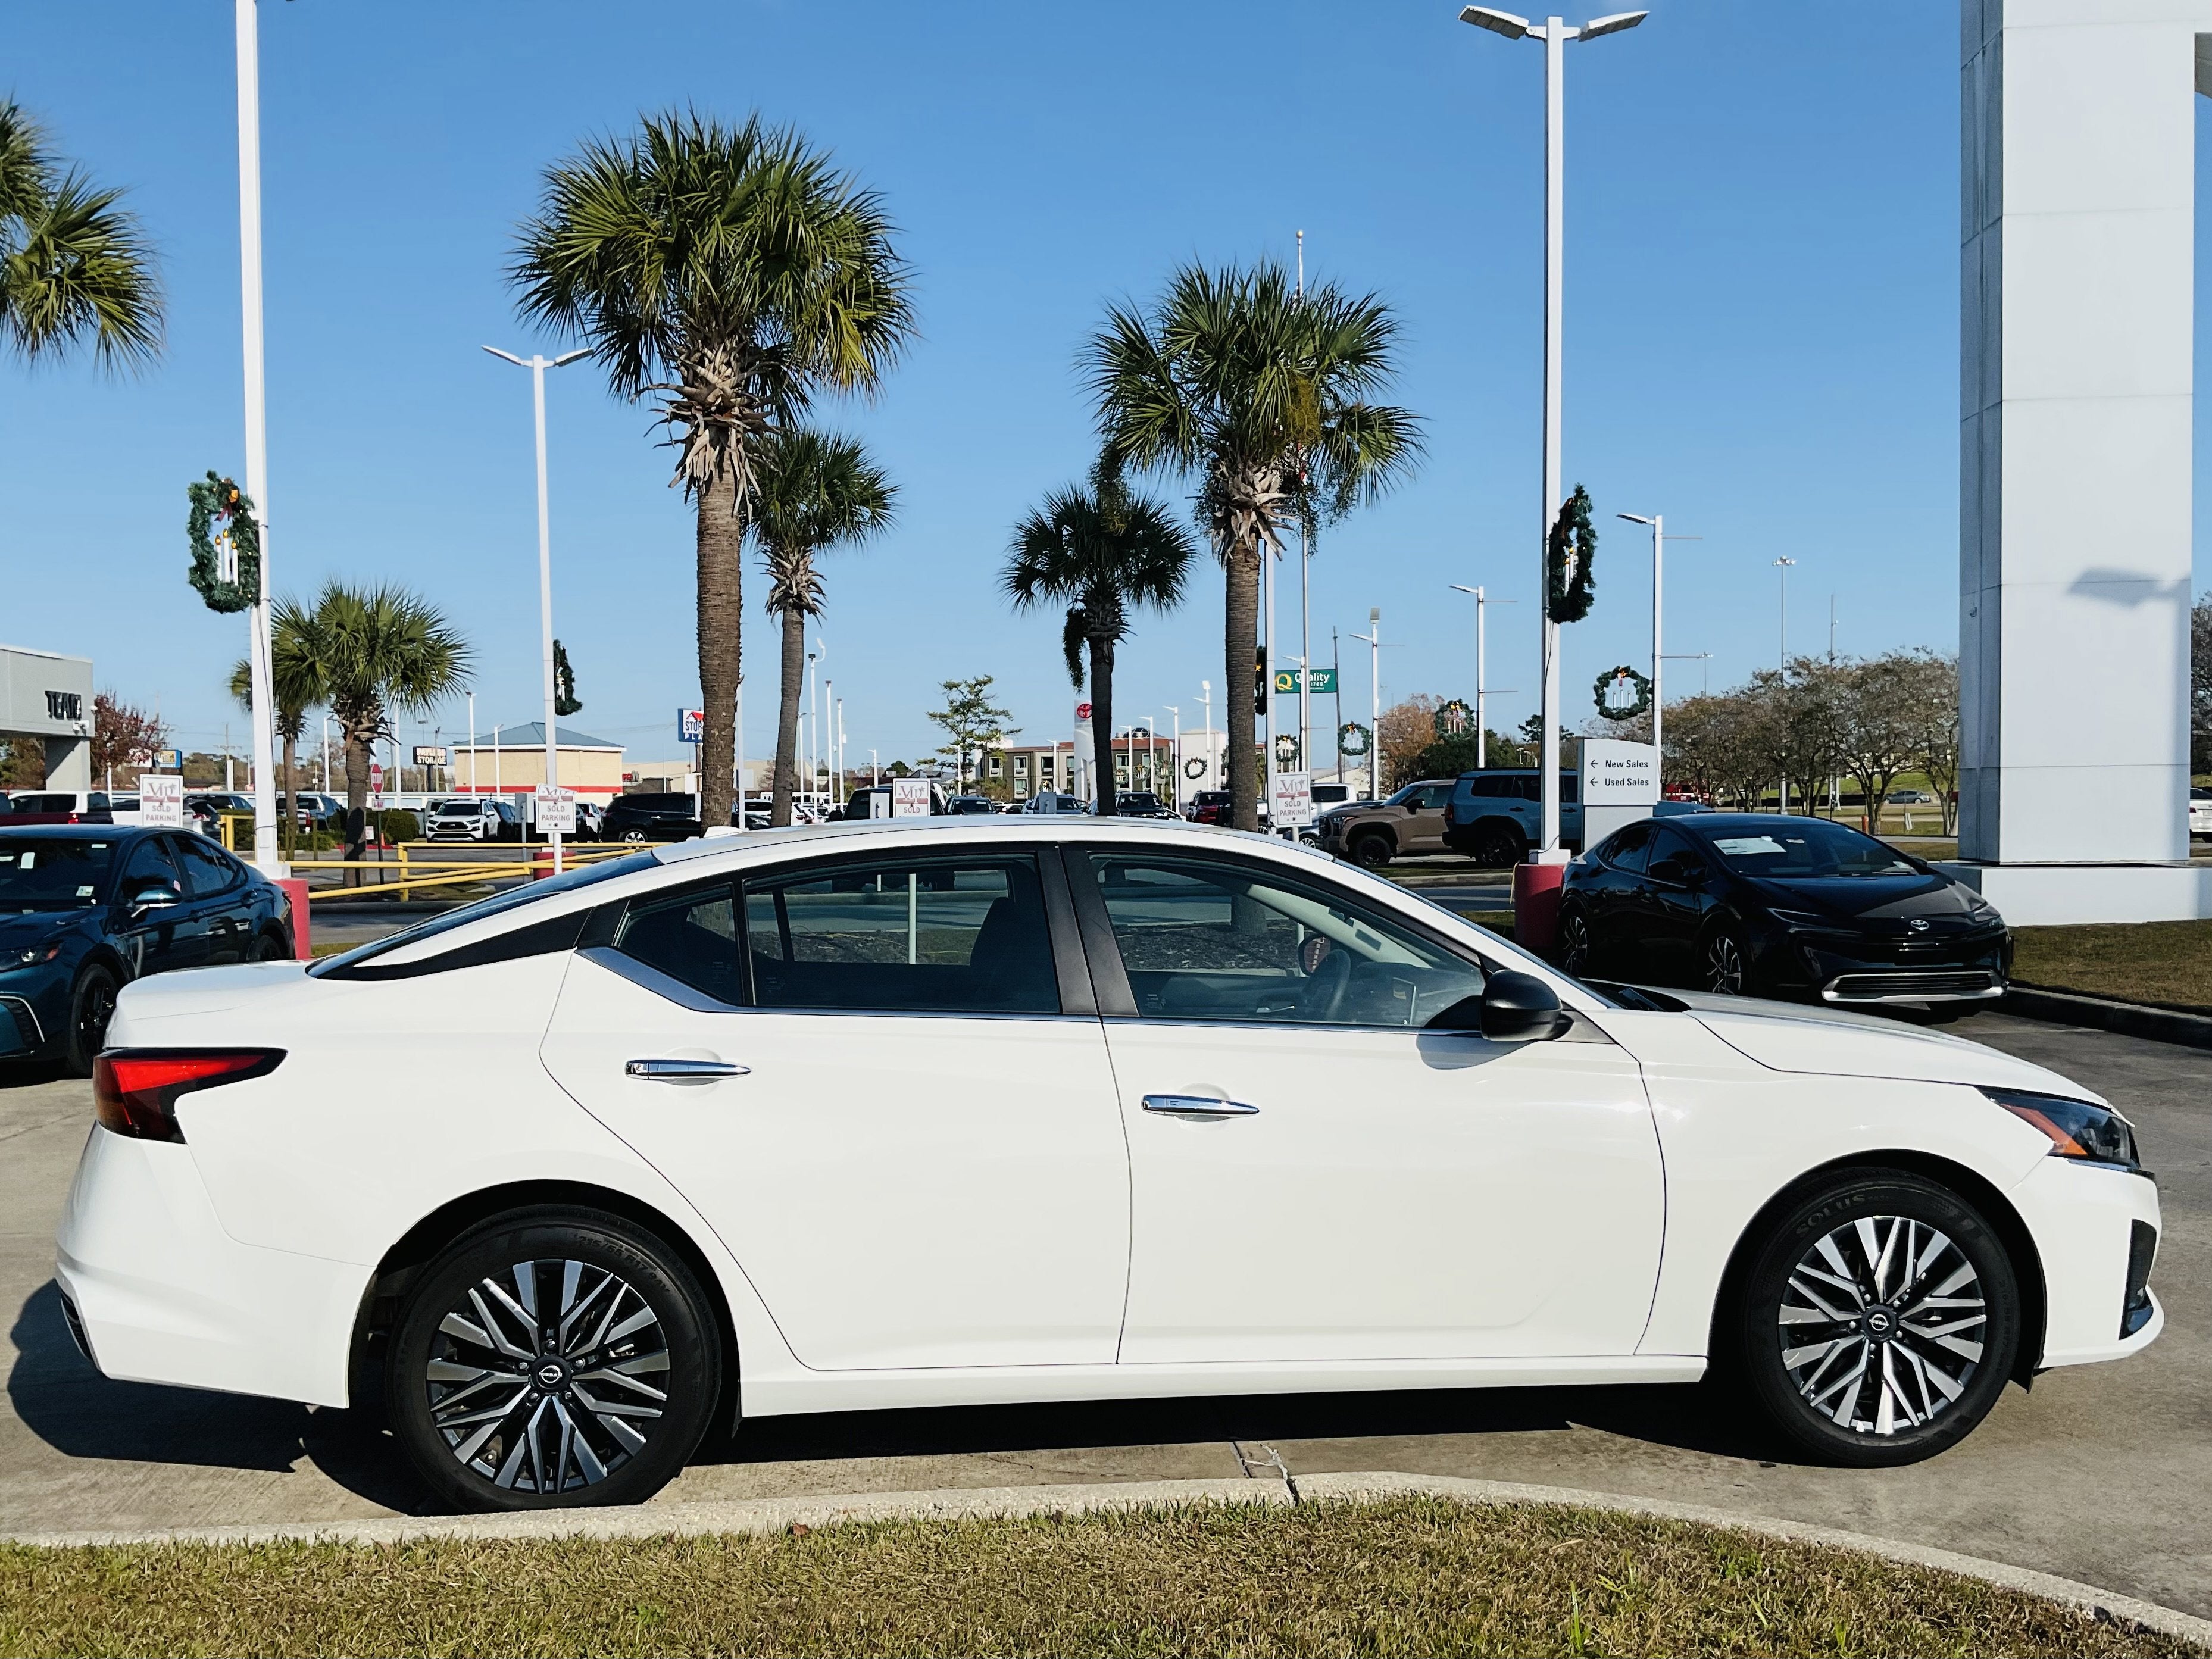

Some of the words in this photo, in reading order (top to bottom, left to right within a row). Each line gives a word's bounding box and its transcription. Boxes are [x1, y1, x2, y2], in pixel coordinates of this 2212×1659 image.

[1294, 672, 1330, 683] Qality
[1605, 760, 1624, 768] New
[1626, 760, 1648, 768] Sales
[1605, 777, 1624, 786] Used
[1627, 777, 1649, 786] Sales
